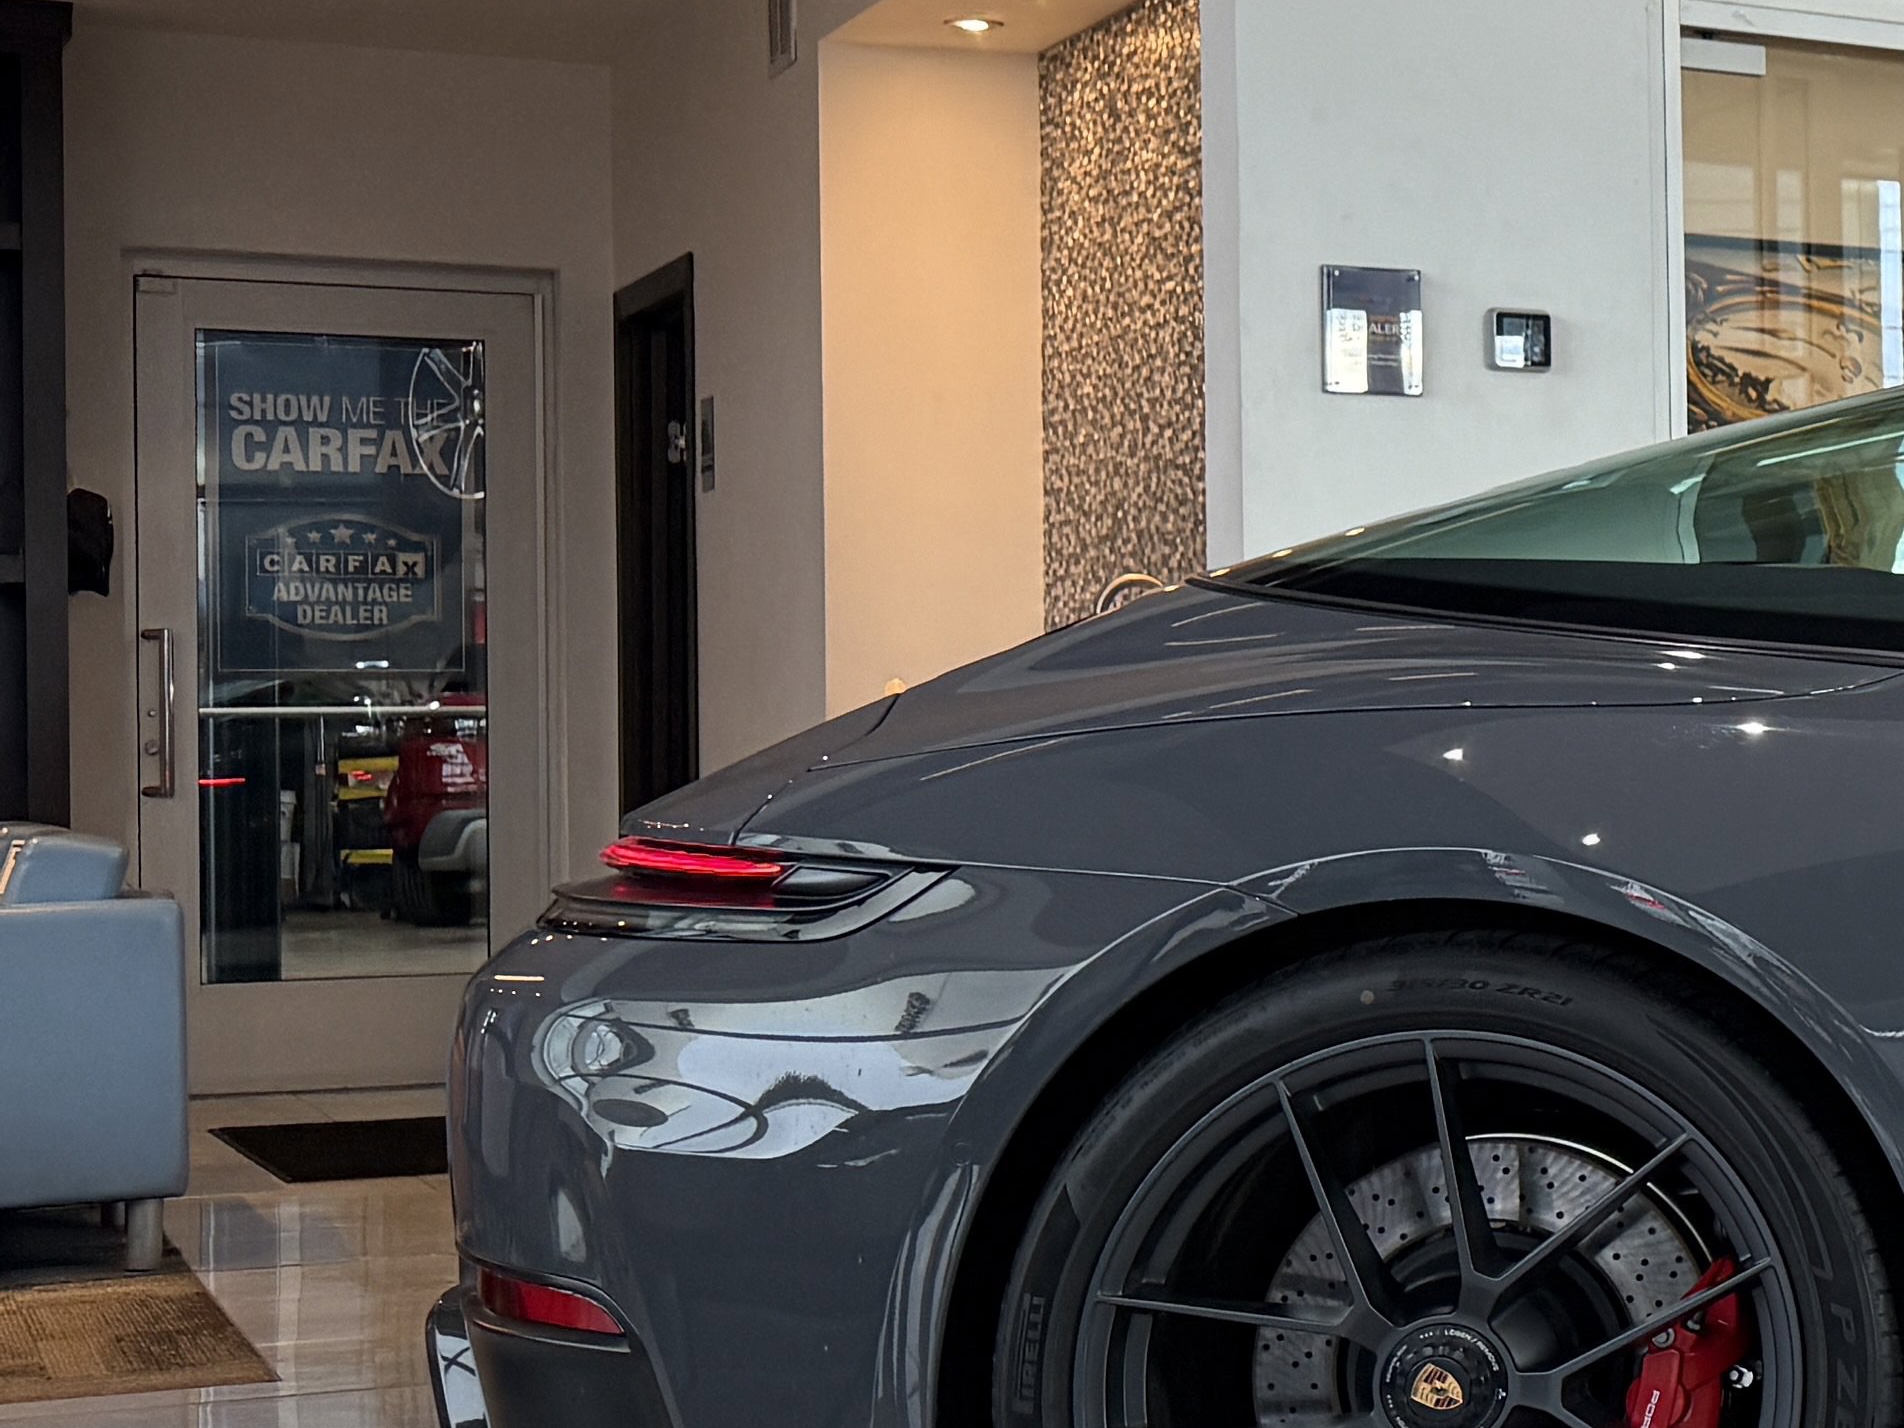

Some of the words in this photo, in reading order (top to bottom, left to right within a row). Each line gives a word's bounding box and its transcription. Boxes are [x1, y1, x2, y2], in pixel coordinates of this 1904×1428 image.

[1369, 322, 1400, 335] ALER
[228, 392, 331, 422] SHOW
[341, 396, 386, 424] ME
[394, 397, 448, 425] THE
[231, 424, 450, 475] CARFAX
[262, 554, 420, 578] CARFAX
[273, 582, 413, 603] ADVANTAGE
[297, 604, 389, 625] DEALER
